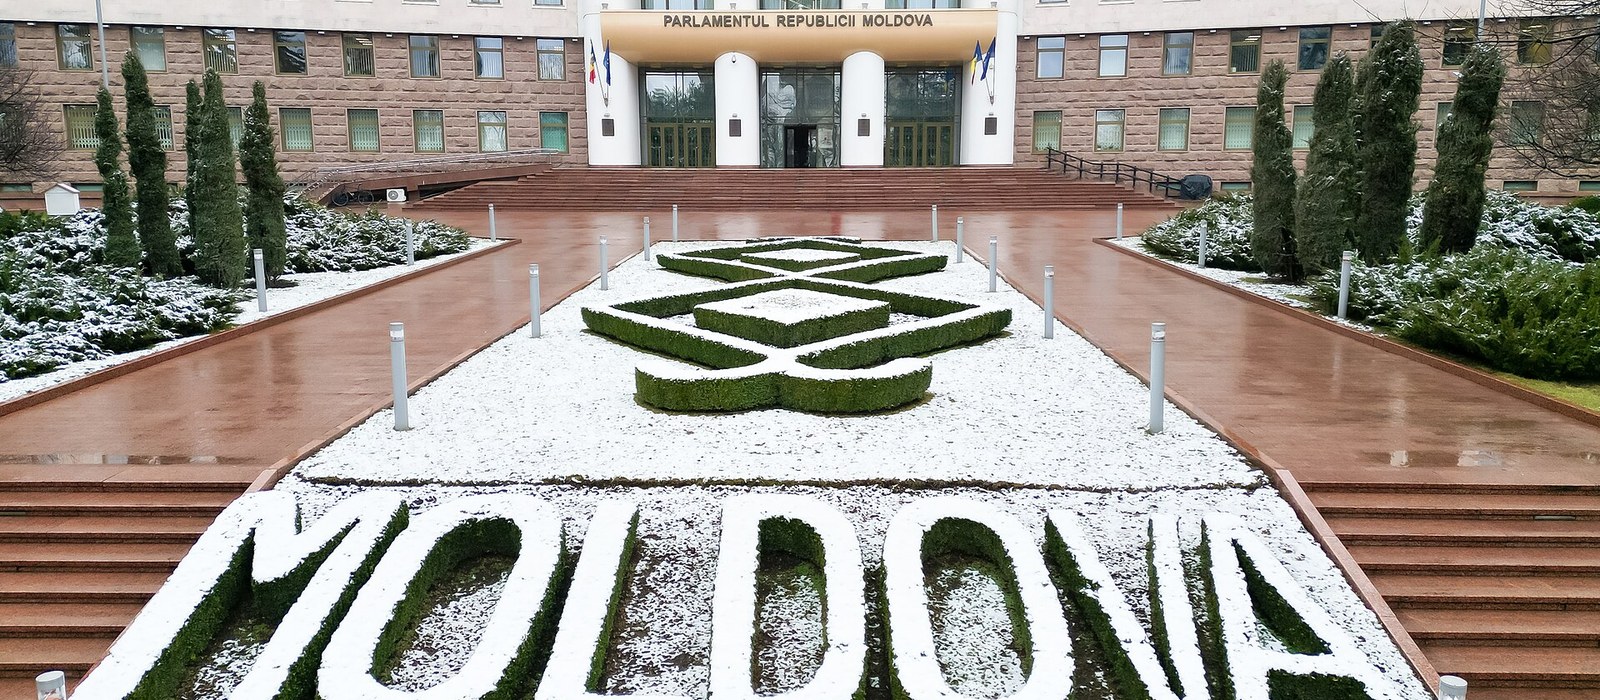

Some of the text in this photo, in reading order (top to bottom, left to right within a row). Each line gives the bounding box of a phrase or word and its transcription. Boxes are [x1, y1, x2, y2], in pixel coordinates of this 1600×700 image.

[663, 14, 933, 28] PARLAMENTUL REPUBLICII MOLDOVA
[68, 489, 1408, 700] MOLDOVA
